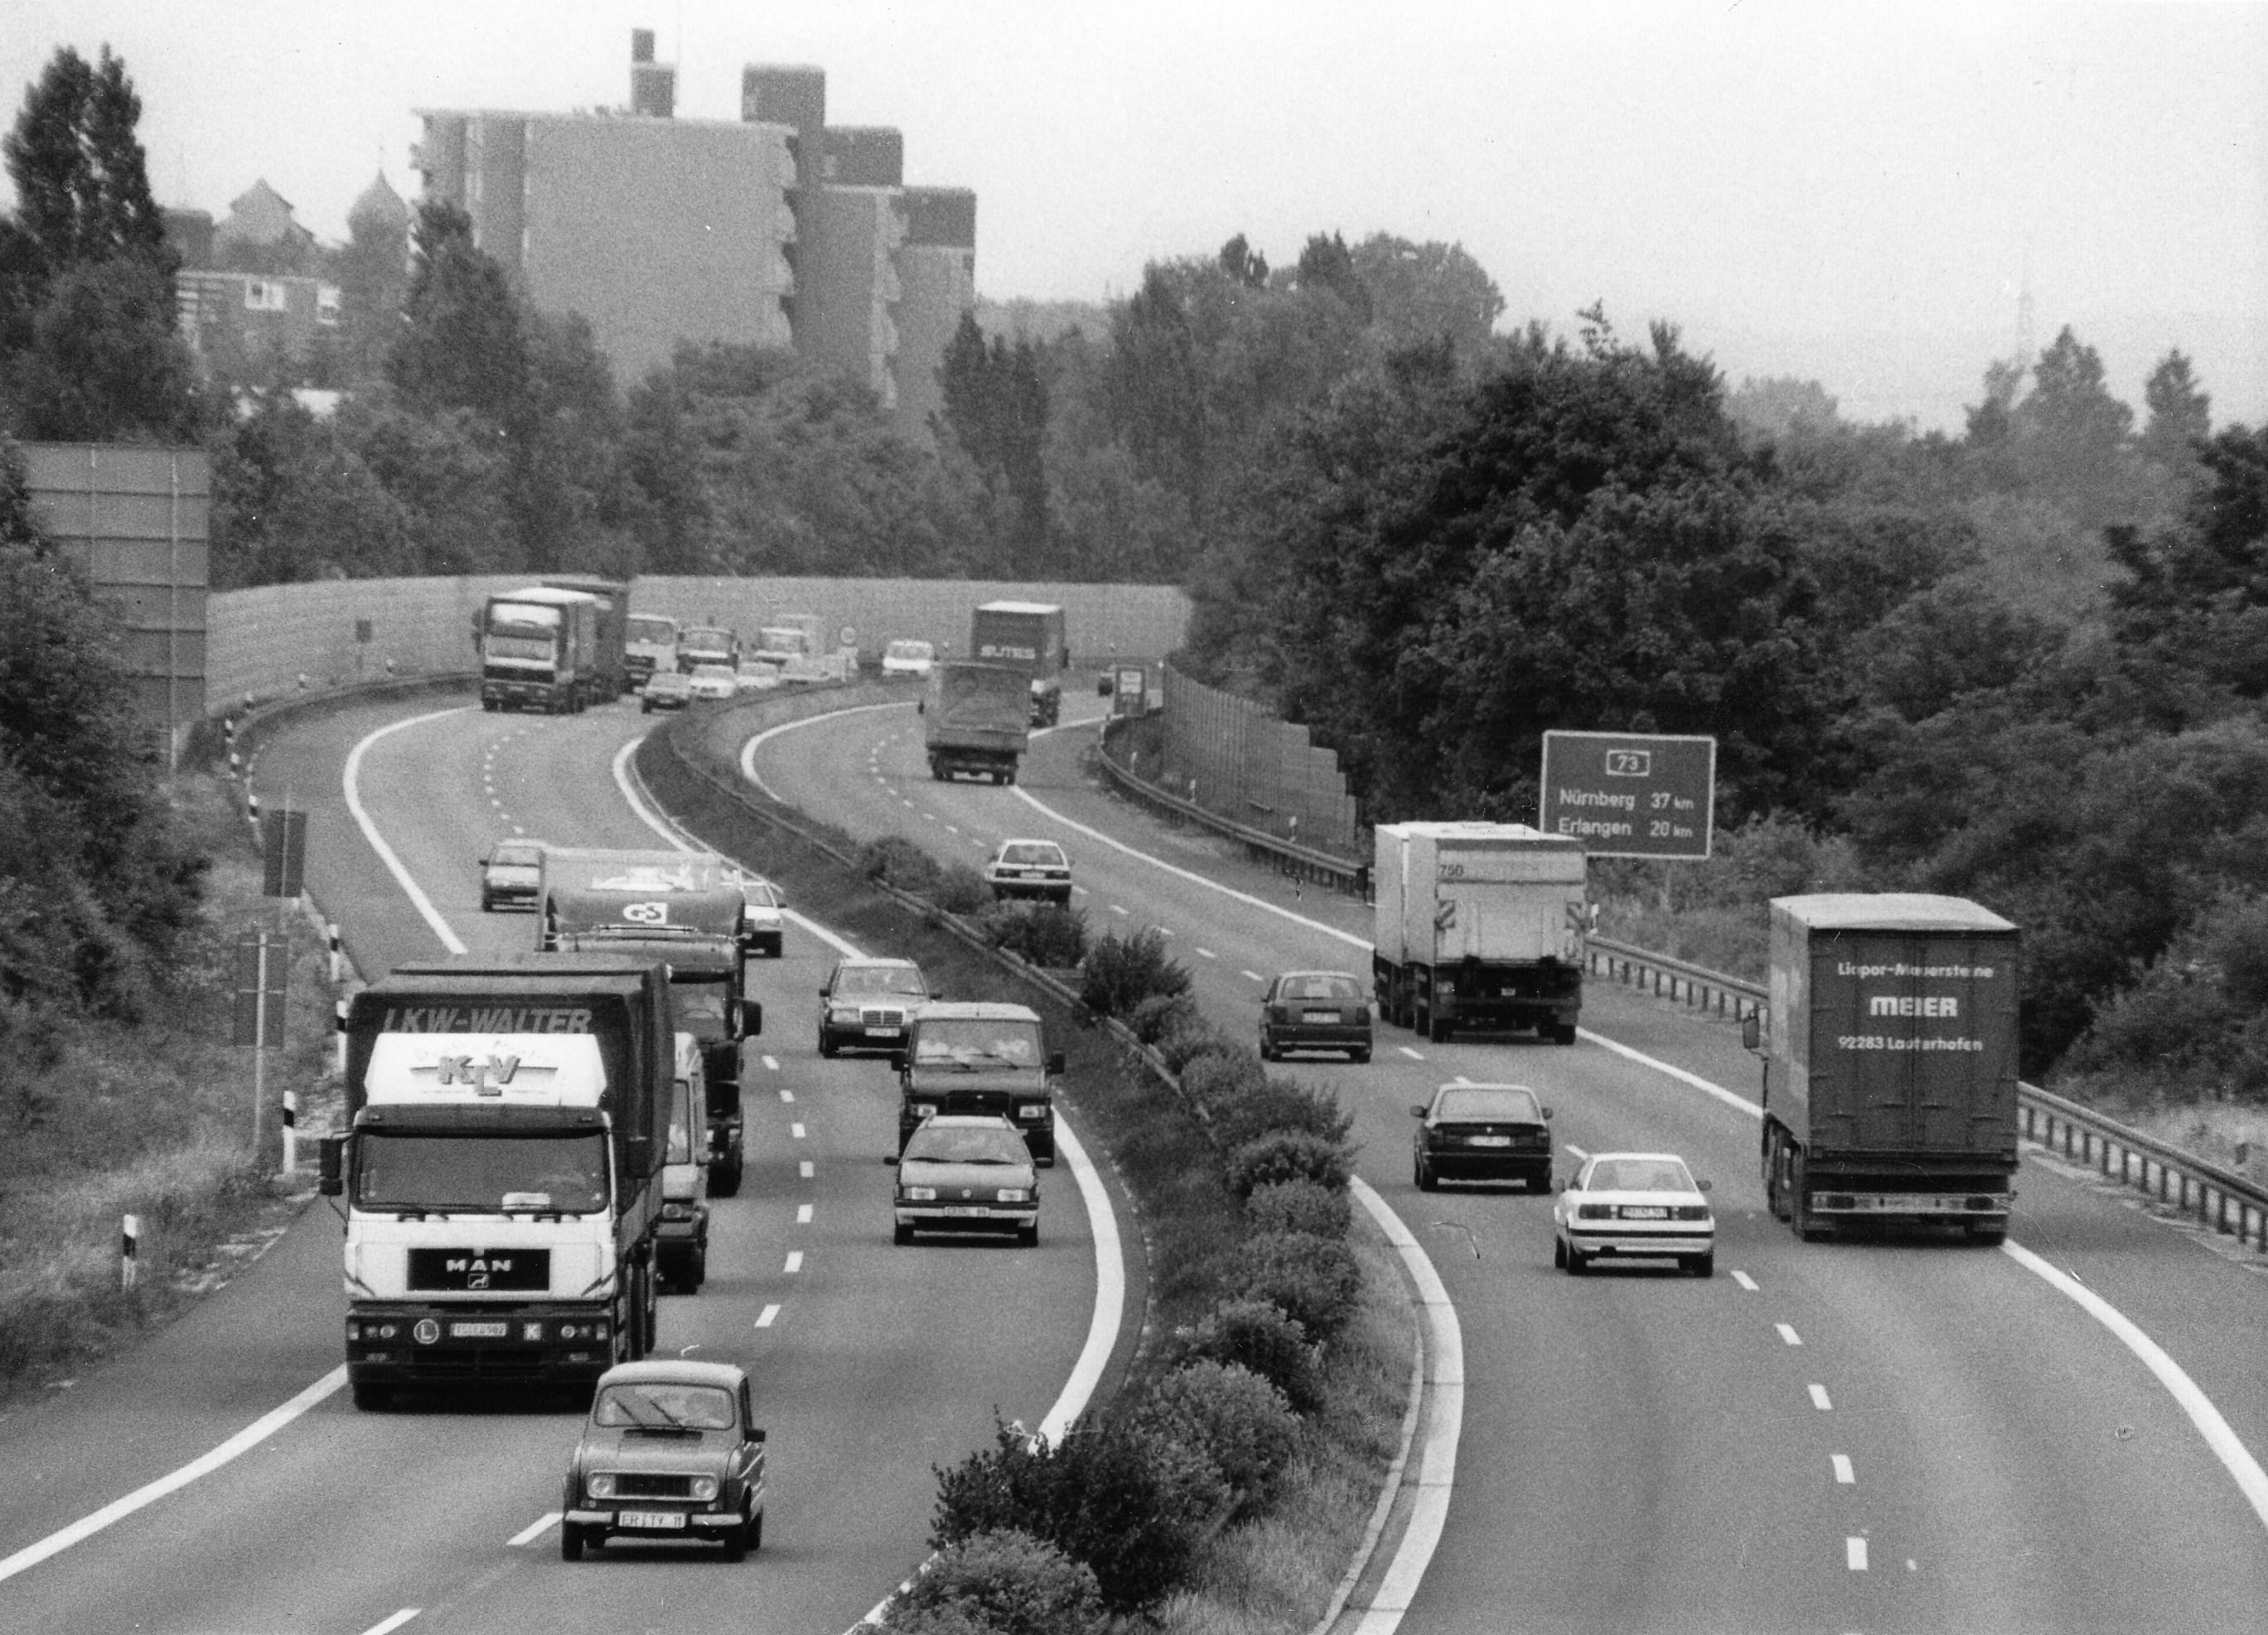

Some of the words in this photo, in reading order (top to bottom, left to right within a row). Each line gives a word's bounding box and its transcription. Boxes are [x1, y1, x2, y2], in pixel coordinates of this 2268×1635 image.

[1617, 755, 1638, 771] 73
[1560, 788, 1635, 811] Nürnberg
[1651, 792, 1671, 809] 37
[1674, 795, 1694, 810] km
[1559, 816, 1632, 839] Erlangen
[1650, 820, 1671, 837] 20
[1673, 824, 1694, 838] km
[1869, 996, 1958, 1017] MEIER
[383, 1008, 592, 1034] LKW-WALTER
[1838, 1036, 1884, 1050] 92283
[1887, 1037, 1984, 1052] Lauterhofen
[445, 1259, 513, 1272] MAN
[526, 1324, 539, 1340] K
